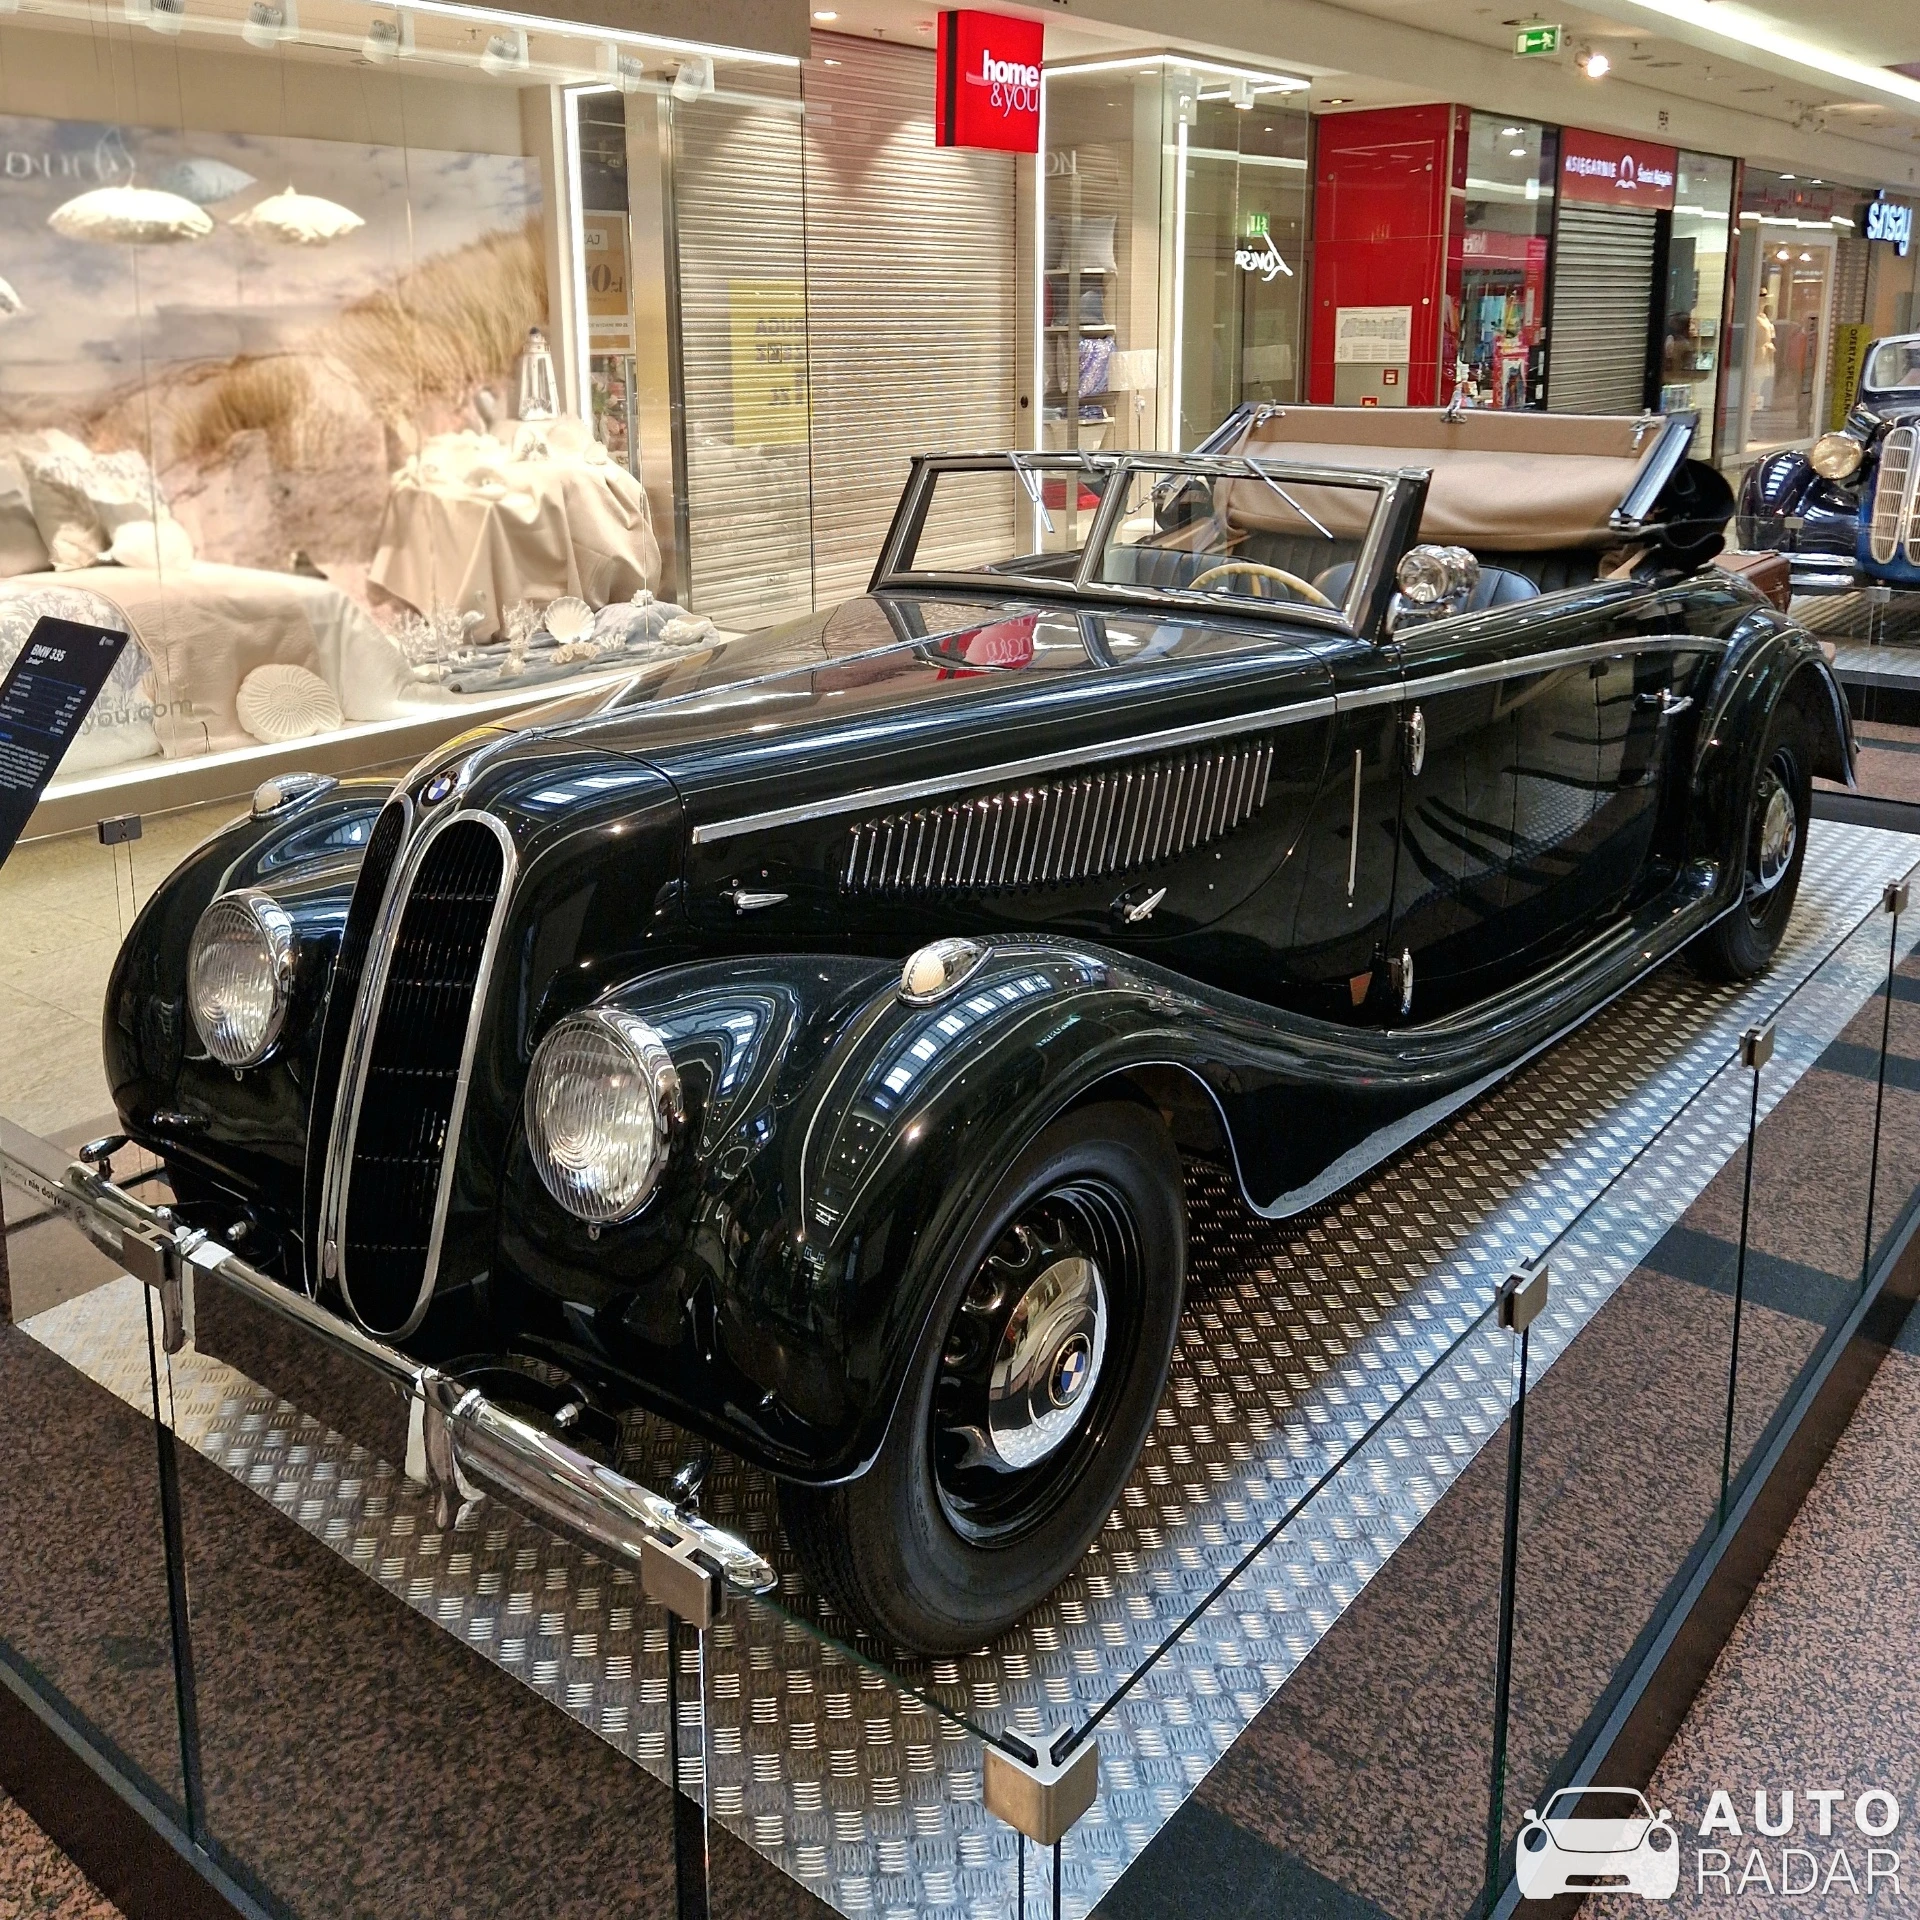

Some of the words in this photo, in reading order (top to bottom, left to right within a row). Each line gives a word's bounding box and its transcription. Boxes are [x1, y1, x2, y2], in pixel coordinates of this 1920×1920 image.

[983, 49, 1039, 88] home
[990, 82, 1038, 118] &you
[583, 234, 601, 246] AJ
[1866, 188, 1912, 257] sinsay
[1847, 328, 1858, 364] OFERTA
[30, 643, 52, 660] BMW
[49, 647, 67, 662] 335
